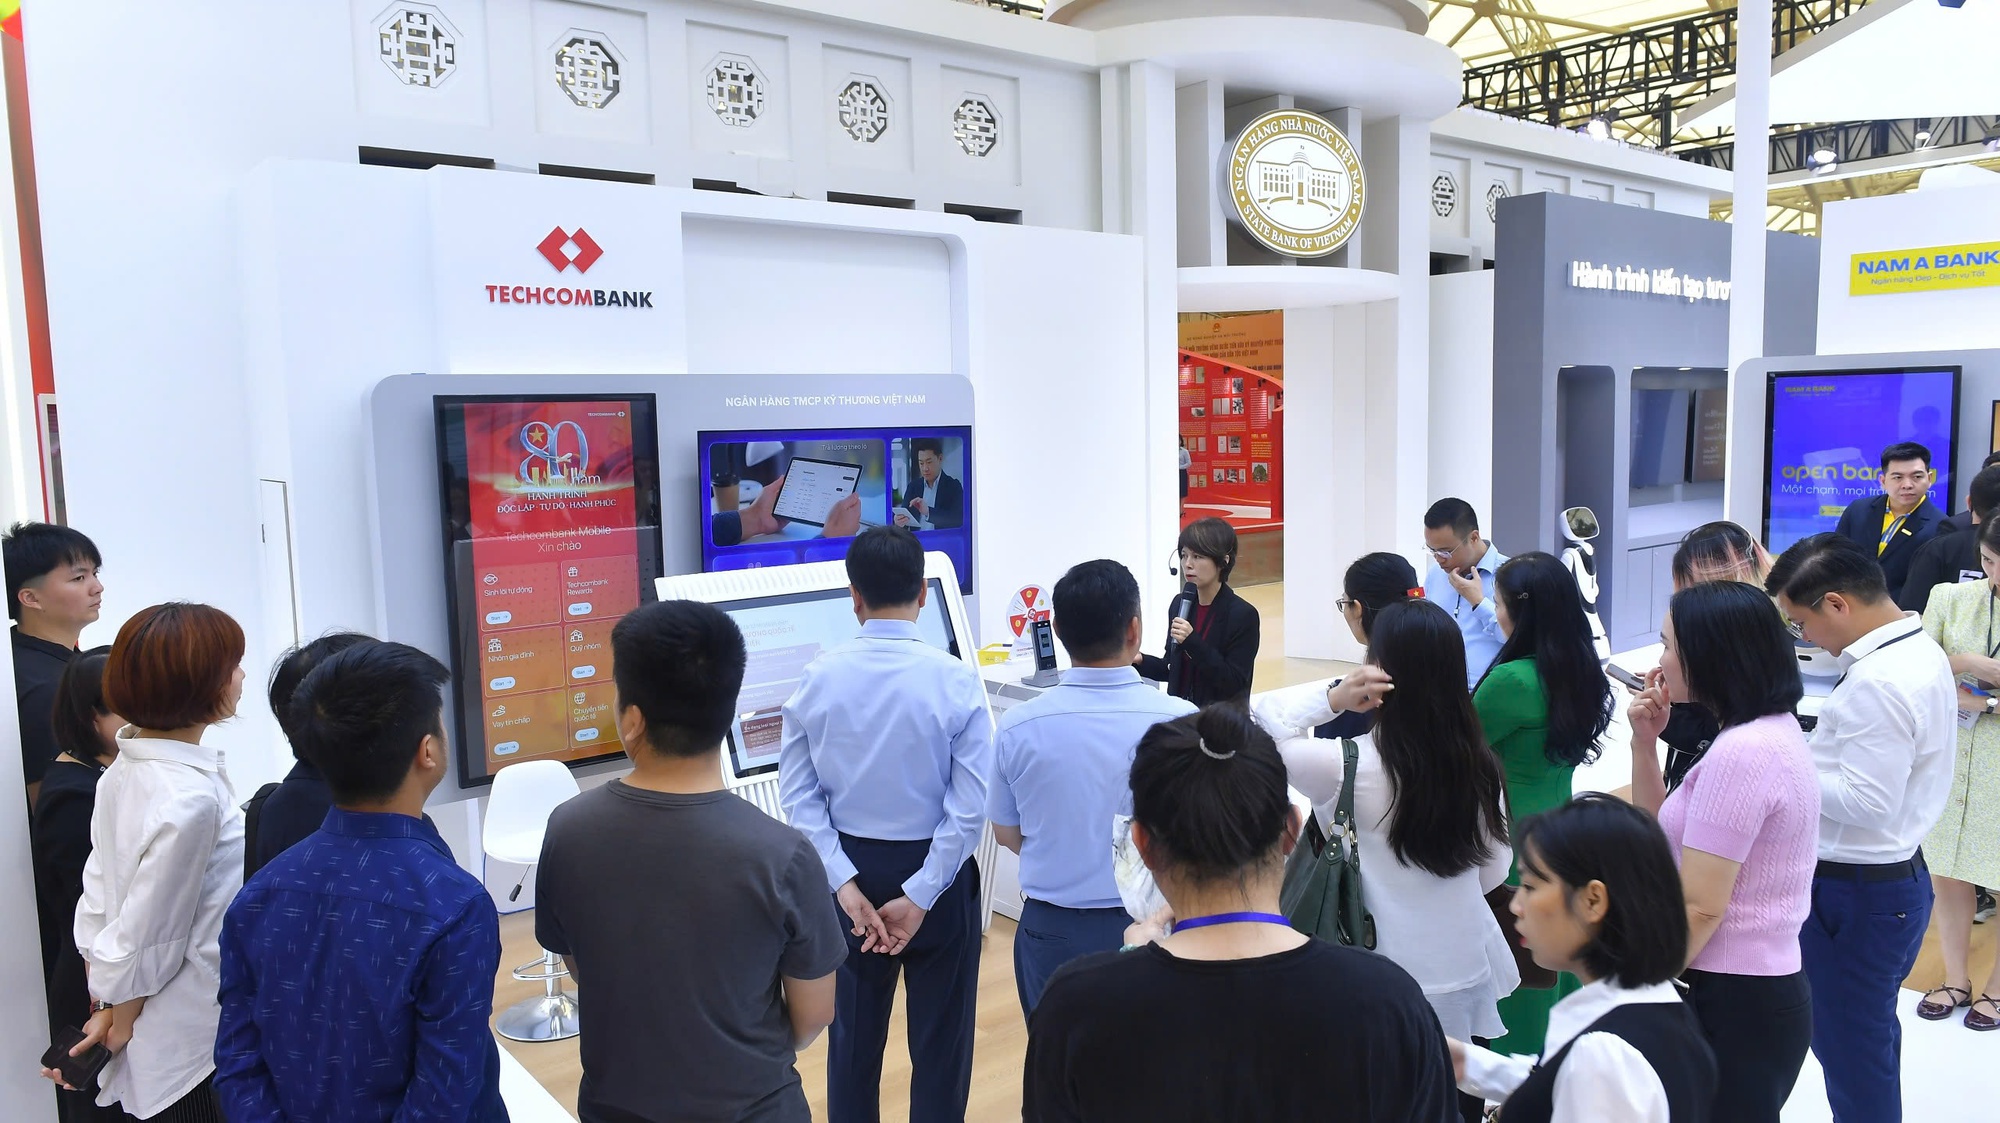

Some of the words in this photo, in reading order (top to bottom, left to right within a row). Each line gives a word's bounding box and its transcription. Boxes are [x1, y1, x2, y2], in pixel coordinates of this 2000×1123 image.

[1235, 146, 1251, 191] NGÂN
[1249, 122, 1279, 146] HÀNG
[1280, 116, 1303, 131] NHÀ
[1304, 120, 1334, 143] NƯỚC
[1335, 138, 1355, 163] VIỆT
[1350, 166, 1361, 205] NAM
[1244, 204, 1270, 236] STATE
[1271, 229, 1299, 248] BANK
[1300, 237, 1313, 249] OF
[1314, 216, 1353, 248] VIETNAM
[1858, 258, 1910, 275] NAM
[1913, 256, 1930, 271] A
[1934, 250, 2000, 269] BANK
[1572, 260, 1613, 290] Hành
[1615, 264, 1650, 293] trình
[1651, 267, 1681, 296] kiến
[1682, 273, 1705, 303] tạo
[485, 285, 653, 308] TECHCOMBANK
[725, 394, 757, 407] NGÂN
[760, 394, 790, 406] HÀNG
[792, 396, 821, 406] TMCP
[824, 394, 836, 405] KỸ
[838, 394, 881, 405] THƯƠNG
[882, 393, 903, 407] VIỆT
[905, 394, 926, 404] NAM
[519, 420, 589, 484] 80
[1781, 465, 1838, 482] open
[1781, 484, 1802, 495] Một
[1806, 485, 1841, 496] chạm,
[1844, 486, 1867, 497] mọi
[497, 504, 517, 513] ĐỘC
[518, 503, 535, 512] LẬP
[539, 503, 551, 511] TỰ
[569, 500, 593, 509] HẠNH
[594, 498, 617, 507] PHÚC
[505, 528, 576, 542] Techcombank
[578, 525, 612, 537] Mobile
[538, 542, 555, 552] Xin
[556, 540, 582, 551] chào
[567, 578, 609, 589] Techcombank
[567, 587, 593, 596] Rewards
[484, 588, 499, 596] Sinh
[488, 653, 509, 663] Nhóm
